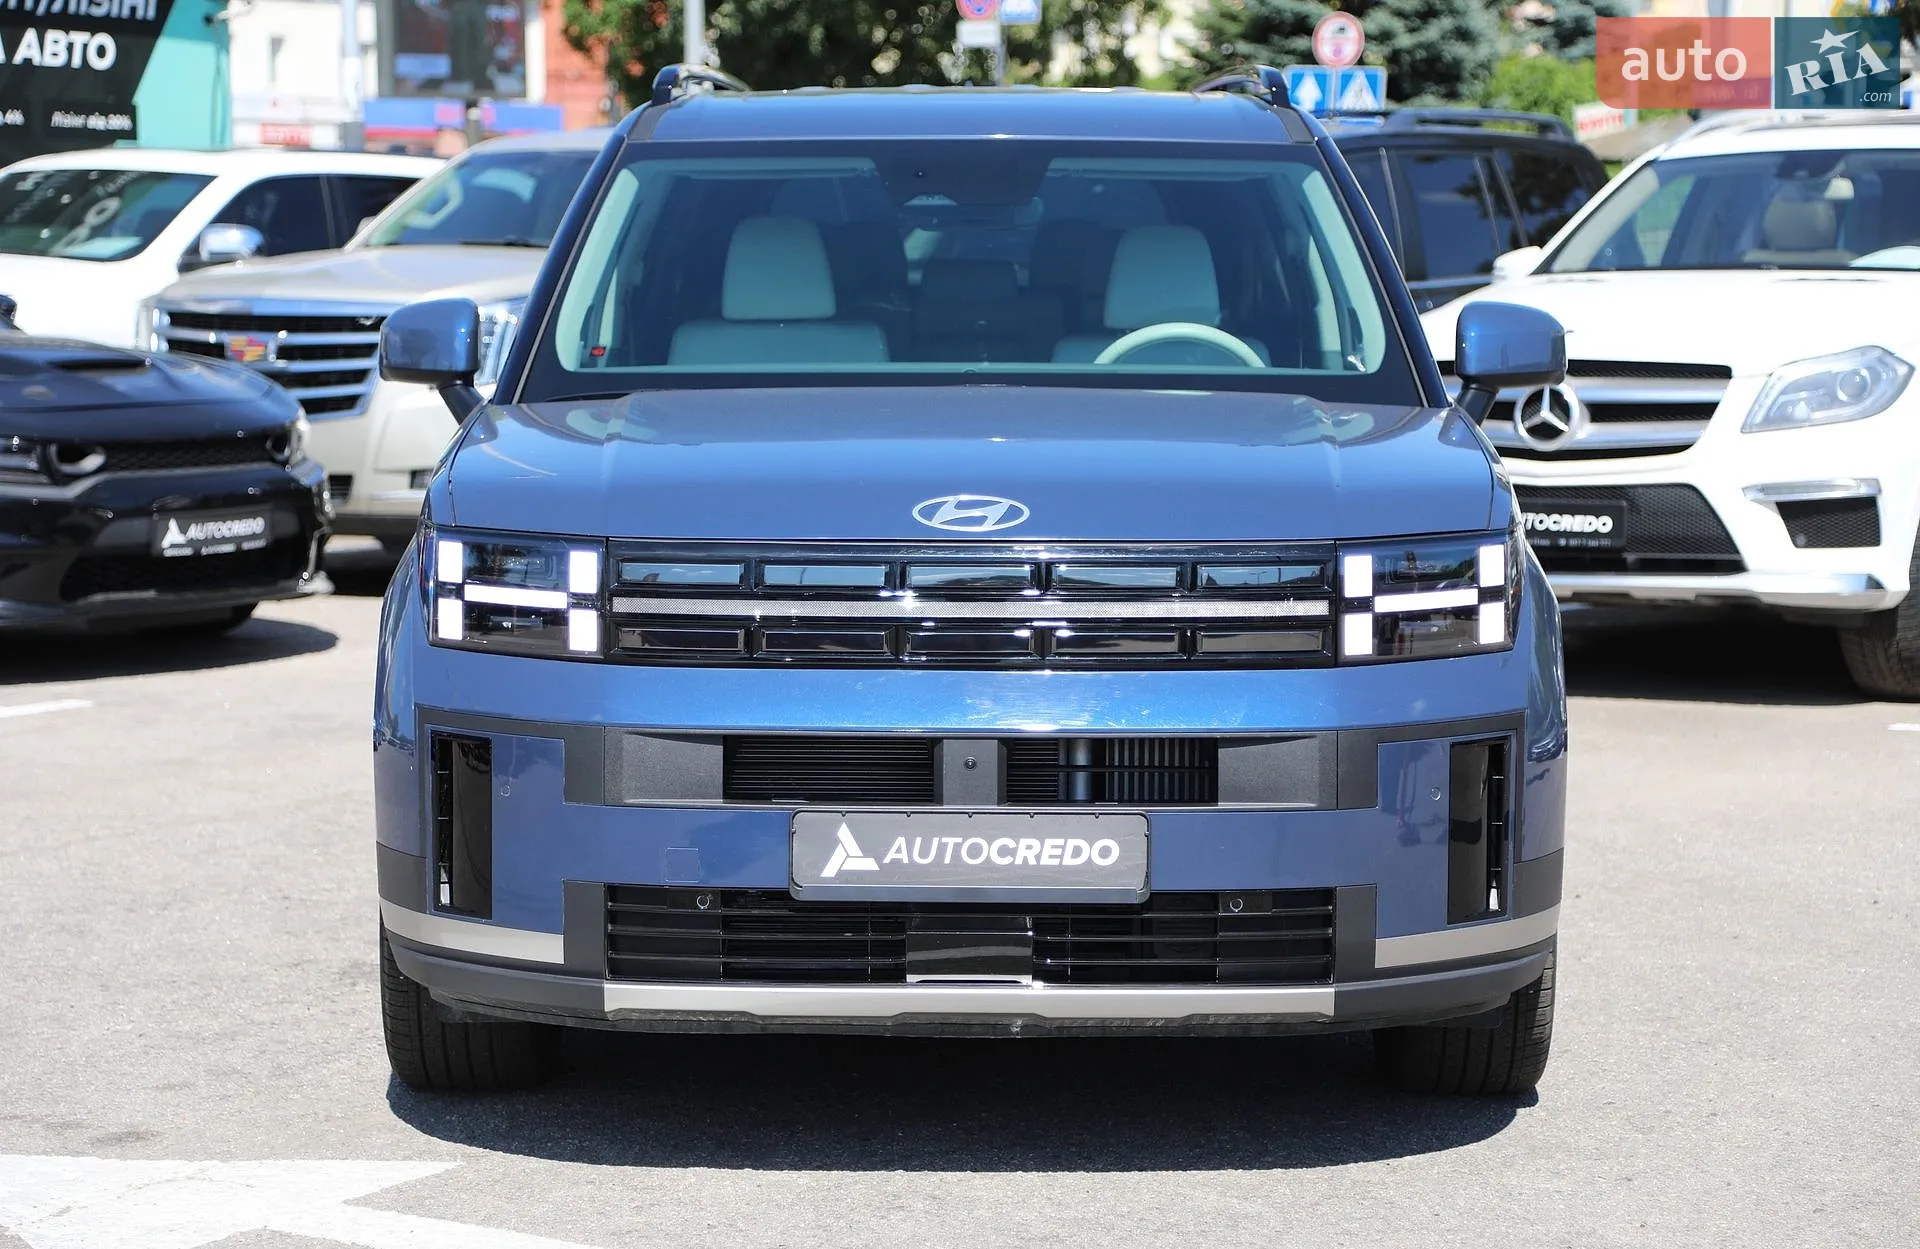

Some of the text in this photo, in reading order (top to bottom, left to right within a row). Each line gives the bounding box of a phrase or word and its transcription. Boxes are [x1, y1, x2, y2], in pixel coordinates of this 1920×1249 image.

[12, 27, 117, 71] АВТО
[184, 516, 266, 541] AUTOCREDO
[1520, 512, 1613, 534] TOCREDO
[882, 836, 1120, 866] AUTOCREDO
